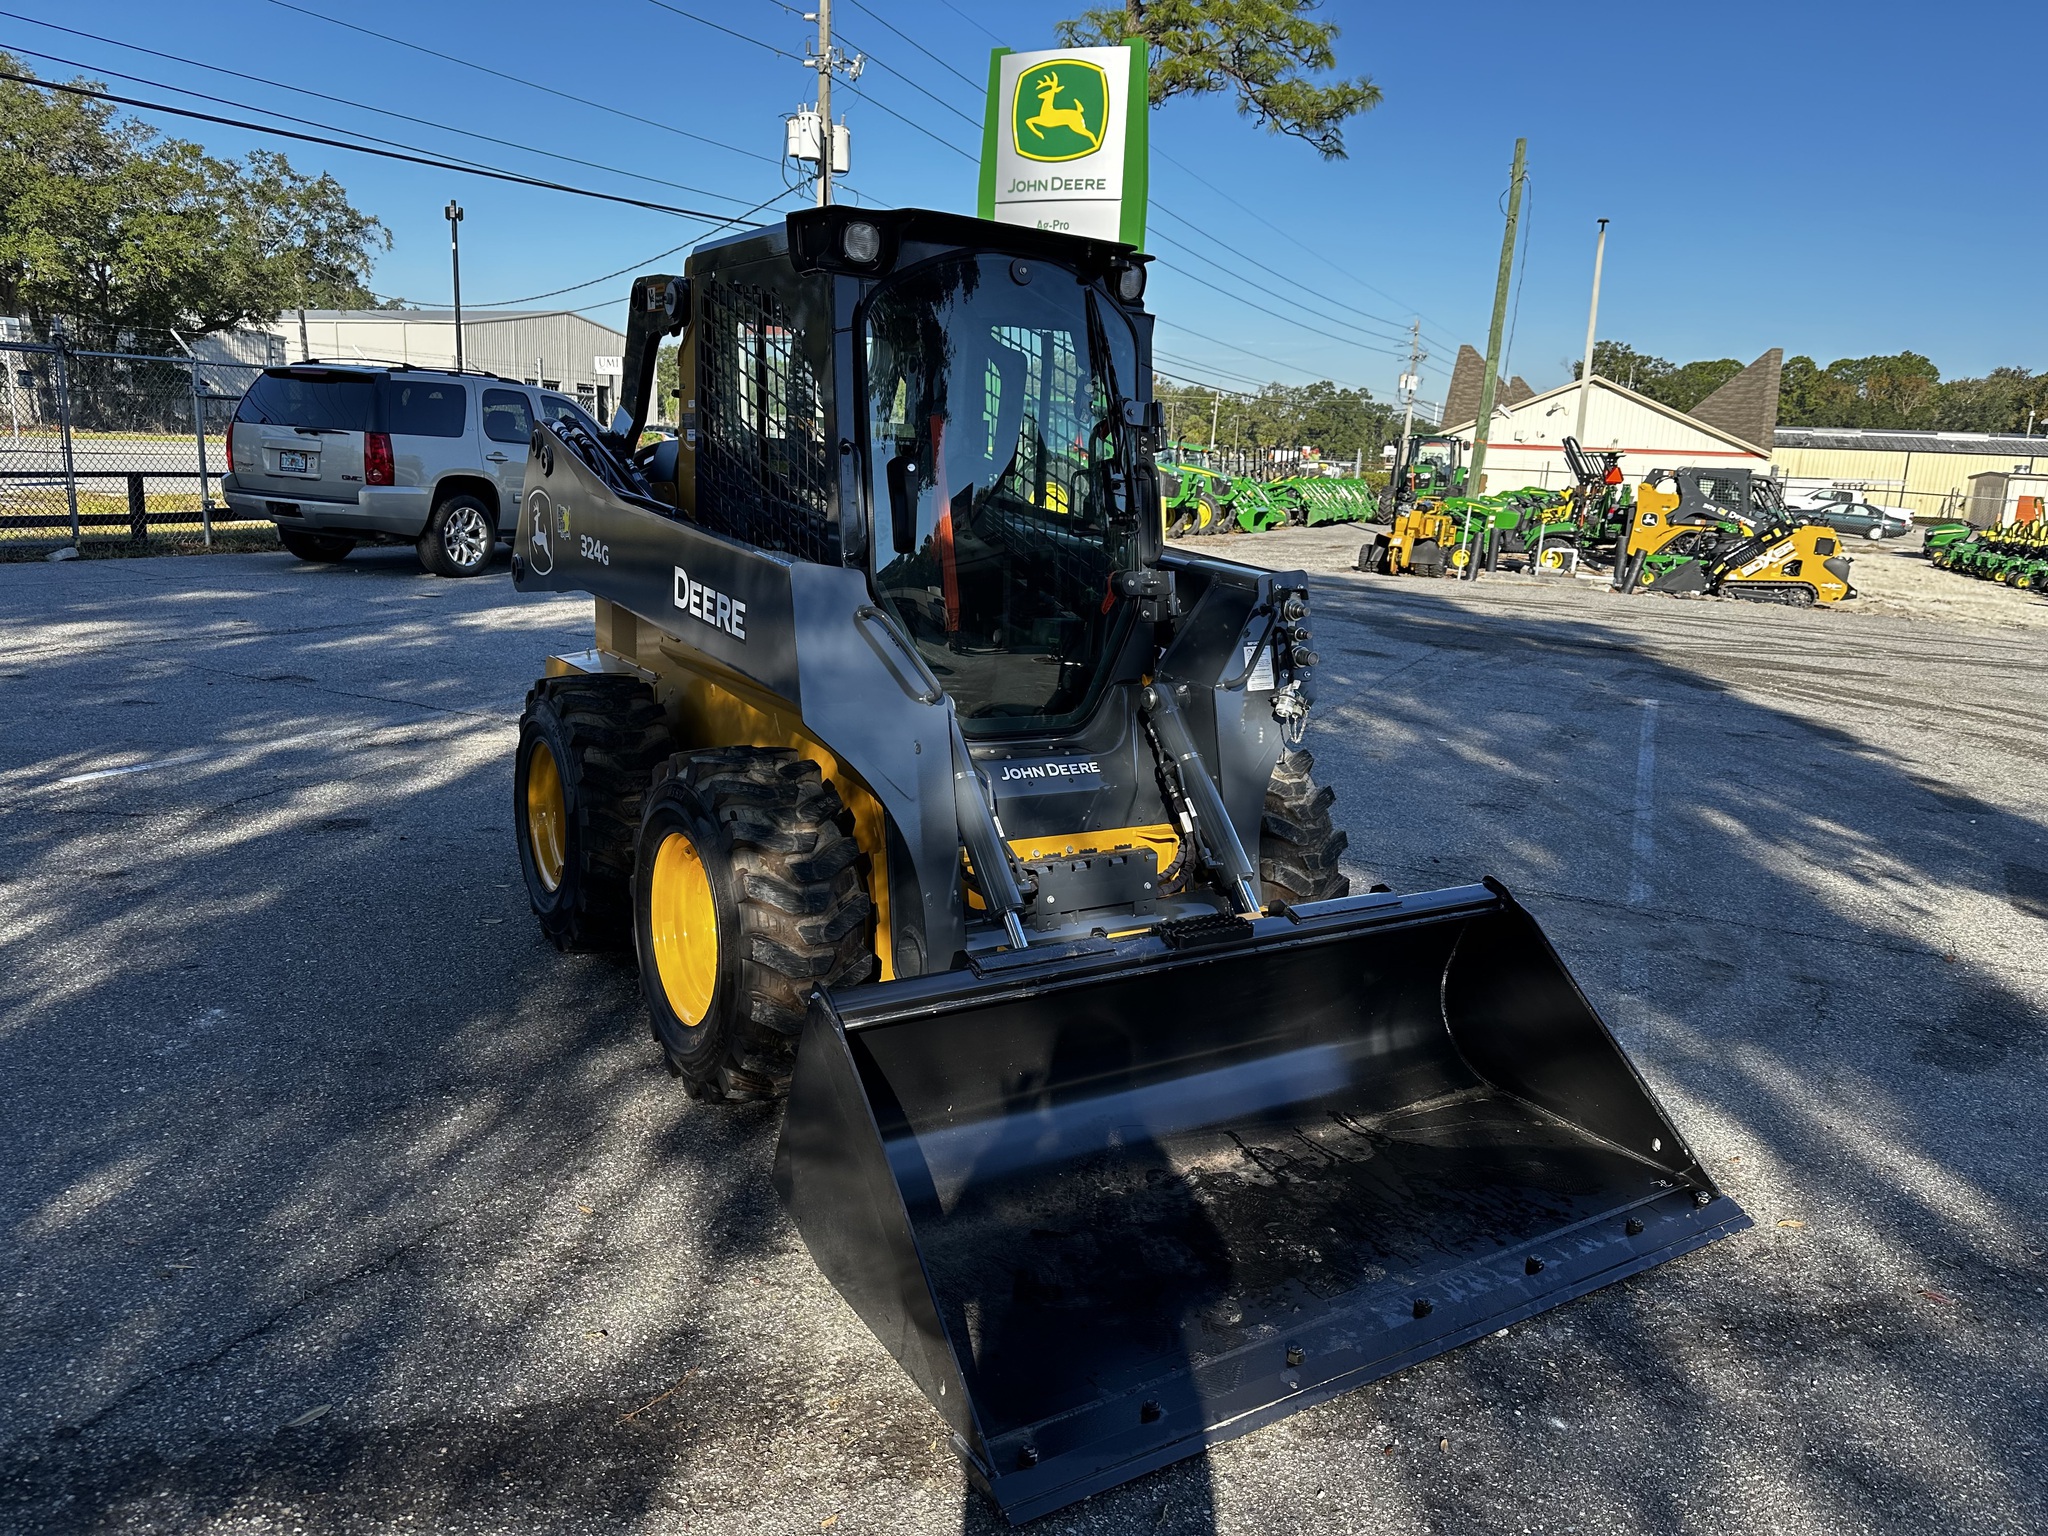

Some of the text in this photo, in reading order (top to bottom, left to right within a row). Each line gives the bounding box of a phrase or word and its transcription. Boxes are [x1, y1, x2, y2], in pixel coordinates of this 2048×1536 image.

[1008, 177, 1106, 193] JOHN DEERE
[1037, 219, 1069, 232] Ag-Pro
[341, 474, 363, 482] GMC
[1728, 510, 1757, 527] DEERE
[580, 534, 609, 566] 324G
[673, 566, 746, 640] DEERE
[1001, 762, 1101, 781] JOHN DEERE
